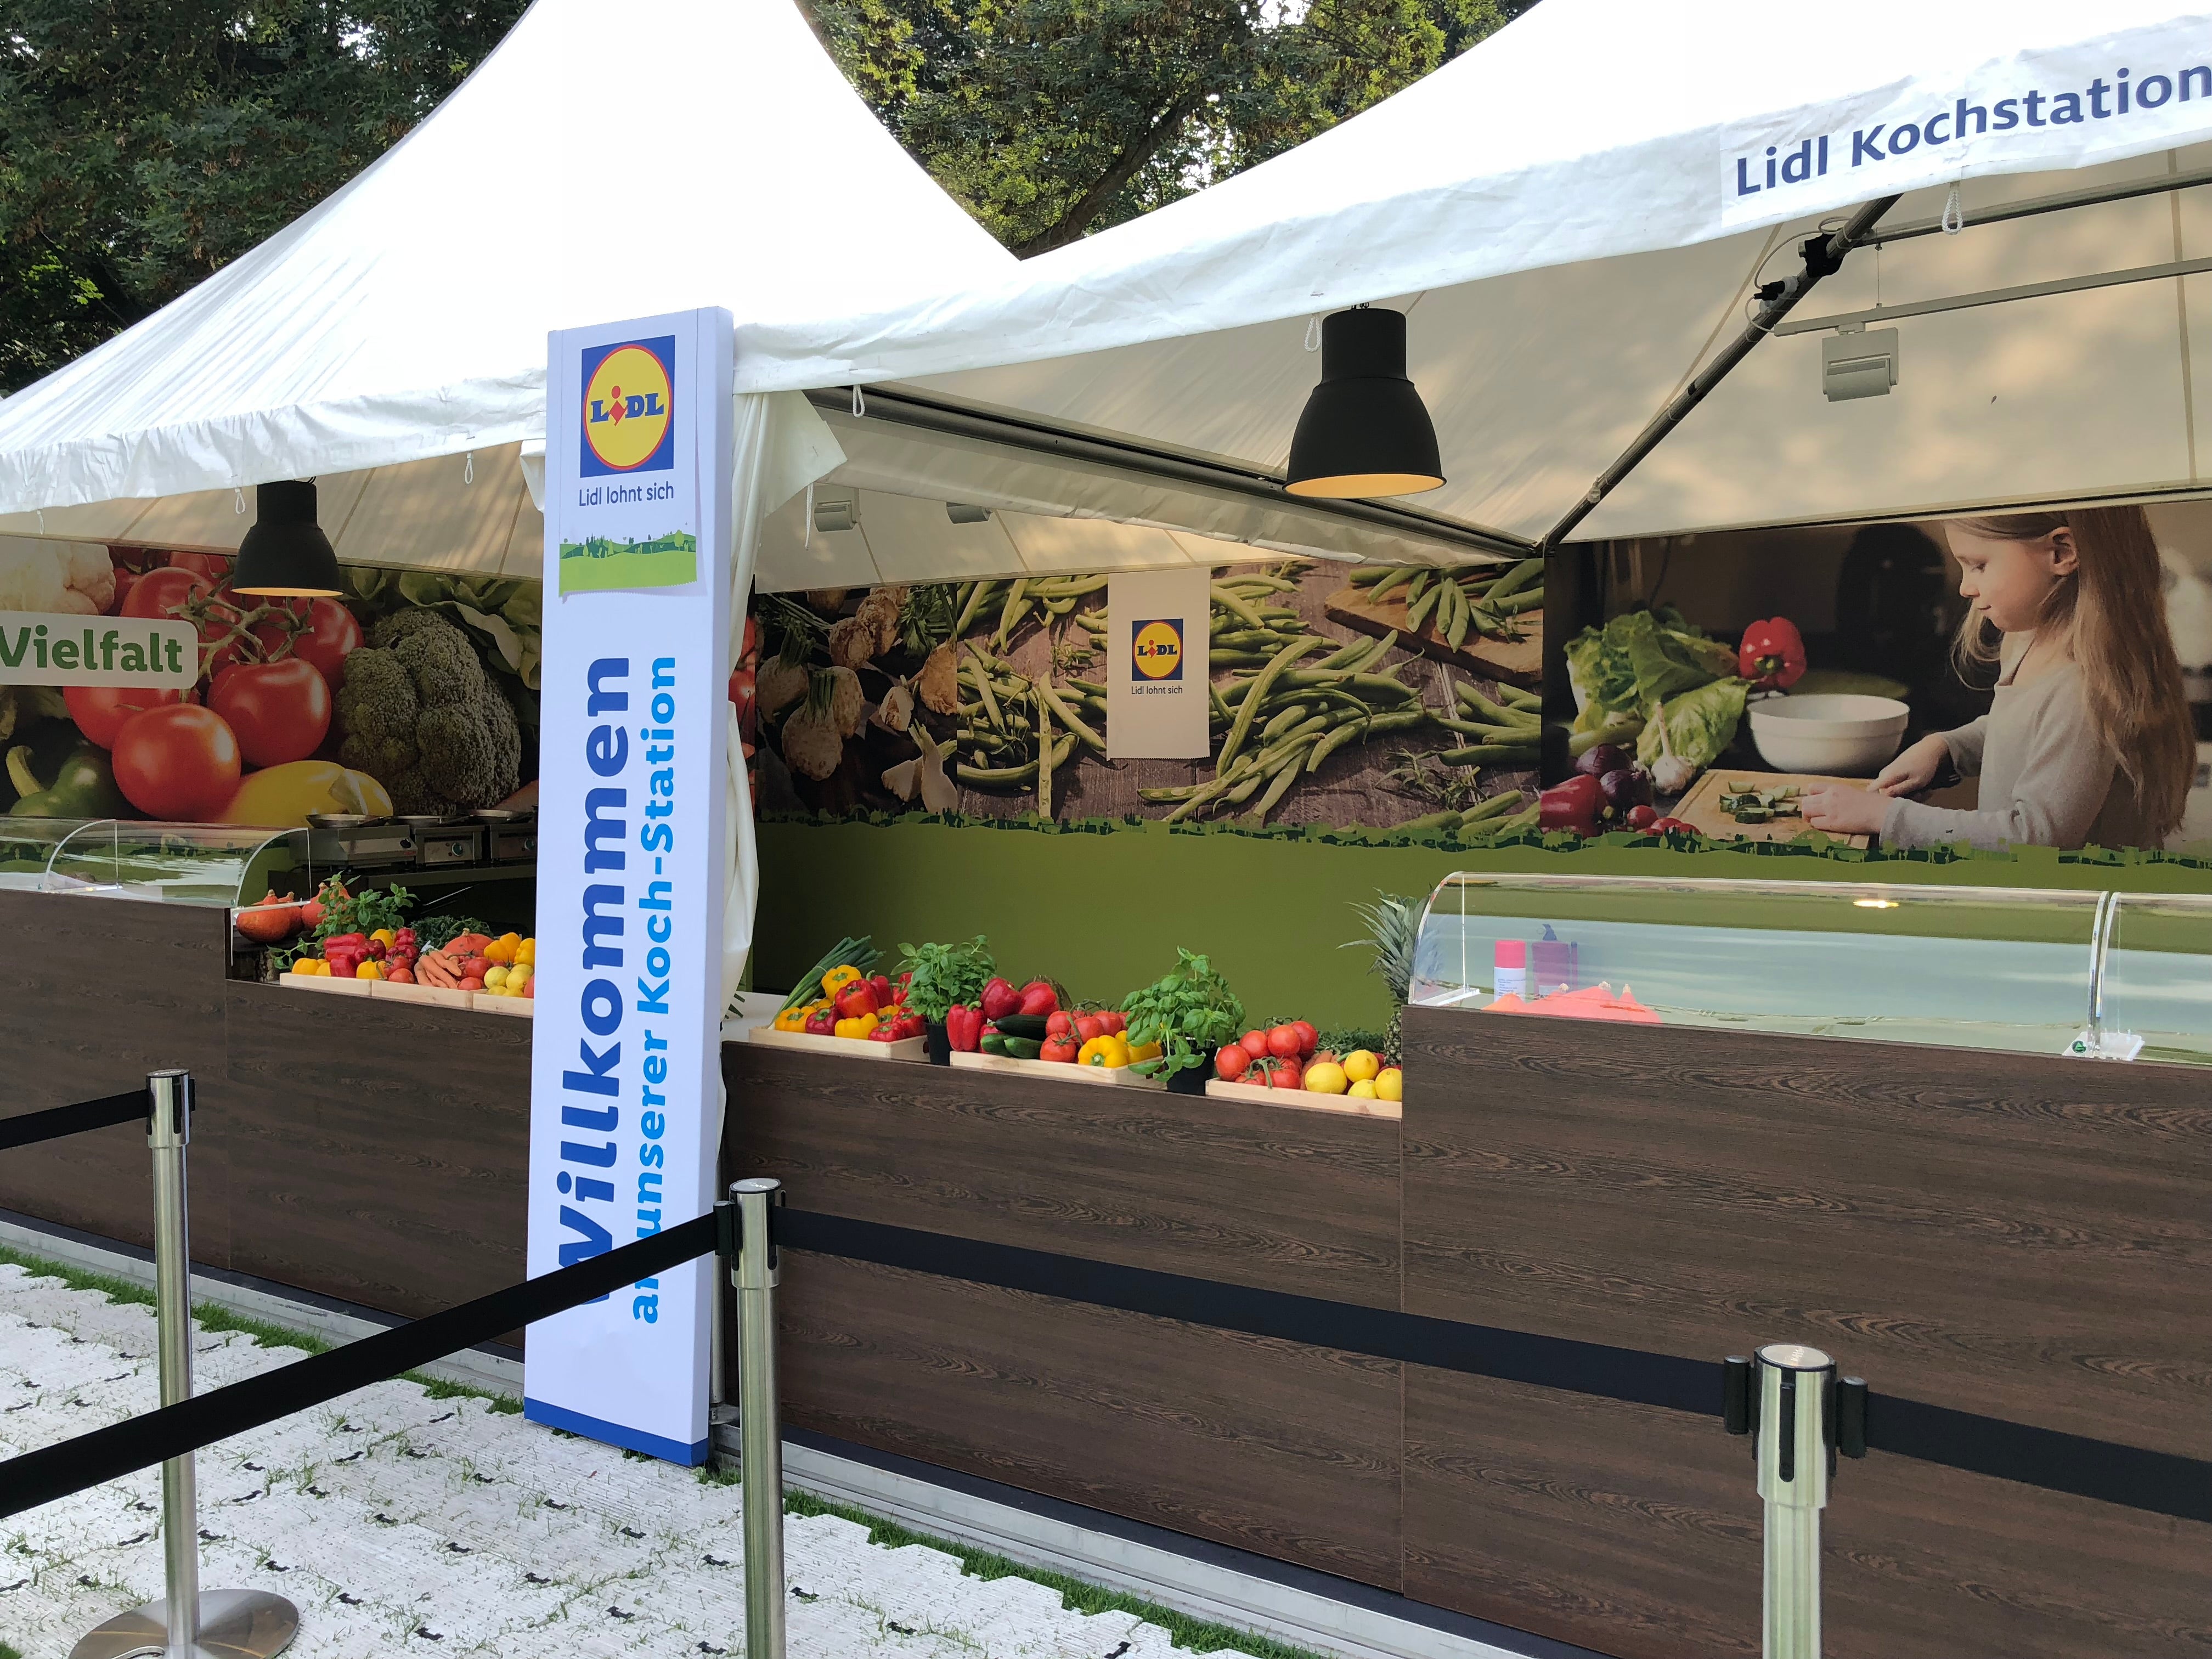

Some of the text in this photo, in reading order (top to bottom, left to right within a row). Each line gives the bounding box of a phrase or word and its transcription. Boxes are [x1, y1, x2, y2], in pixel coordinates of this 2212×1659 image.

[1736, 64, 2212, 196] Lidl Kochstation
[579, 481, 674, 506] Lidl lohnt sich
[0, 624, 183, 674] Vielfalt
[1131, 685, 1183, 695] Lidl lohnt sich
[636, 657, 676, 1015] Koch-Station
[636, 1029, 668, 1239] unserer
